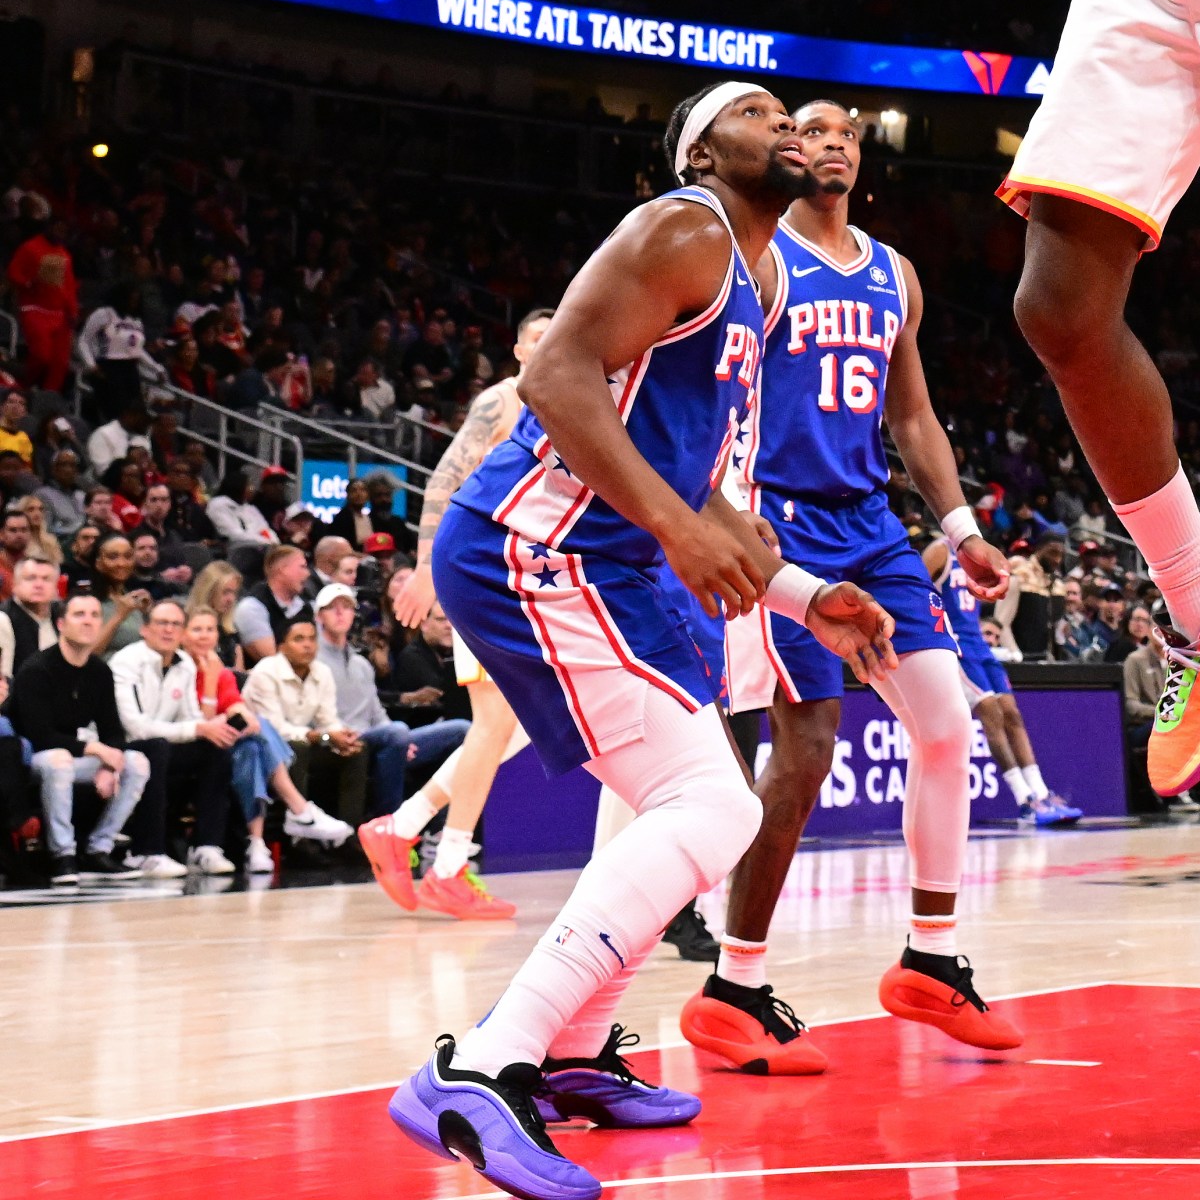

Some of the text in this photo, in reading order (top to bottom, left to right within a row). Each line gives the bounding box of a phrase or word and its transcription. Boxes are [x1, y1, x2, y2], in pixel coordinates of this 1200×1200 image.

[535, 6, 583, 46] ATL
[588, 13, 675, 57] TAKES
[678, 25, 777, 70] FLIGHT.
[818, 353, 879, 413] 16
[865, 761, 999, 804] CAOS
